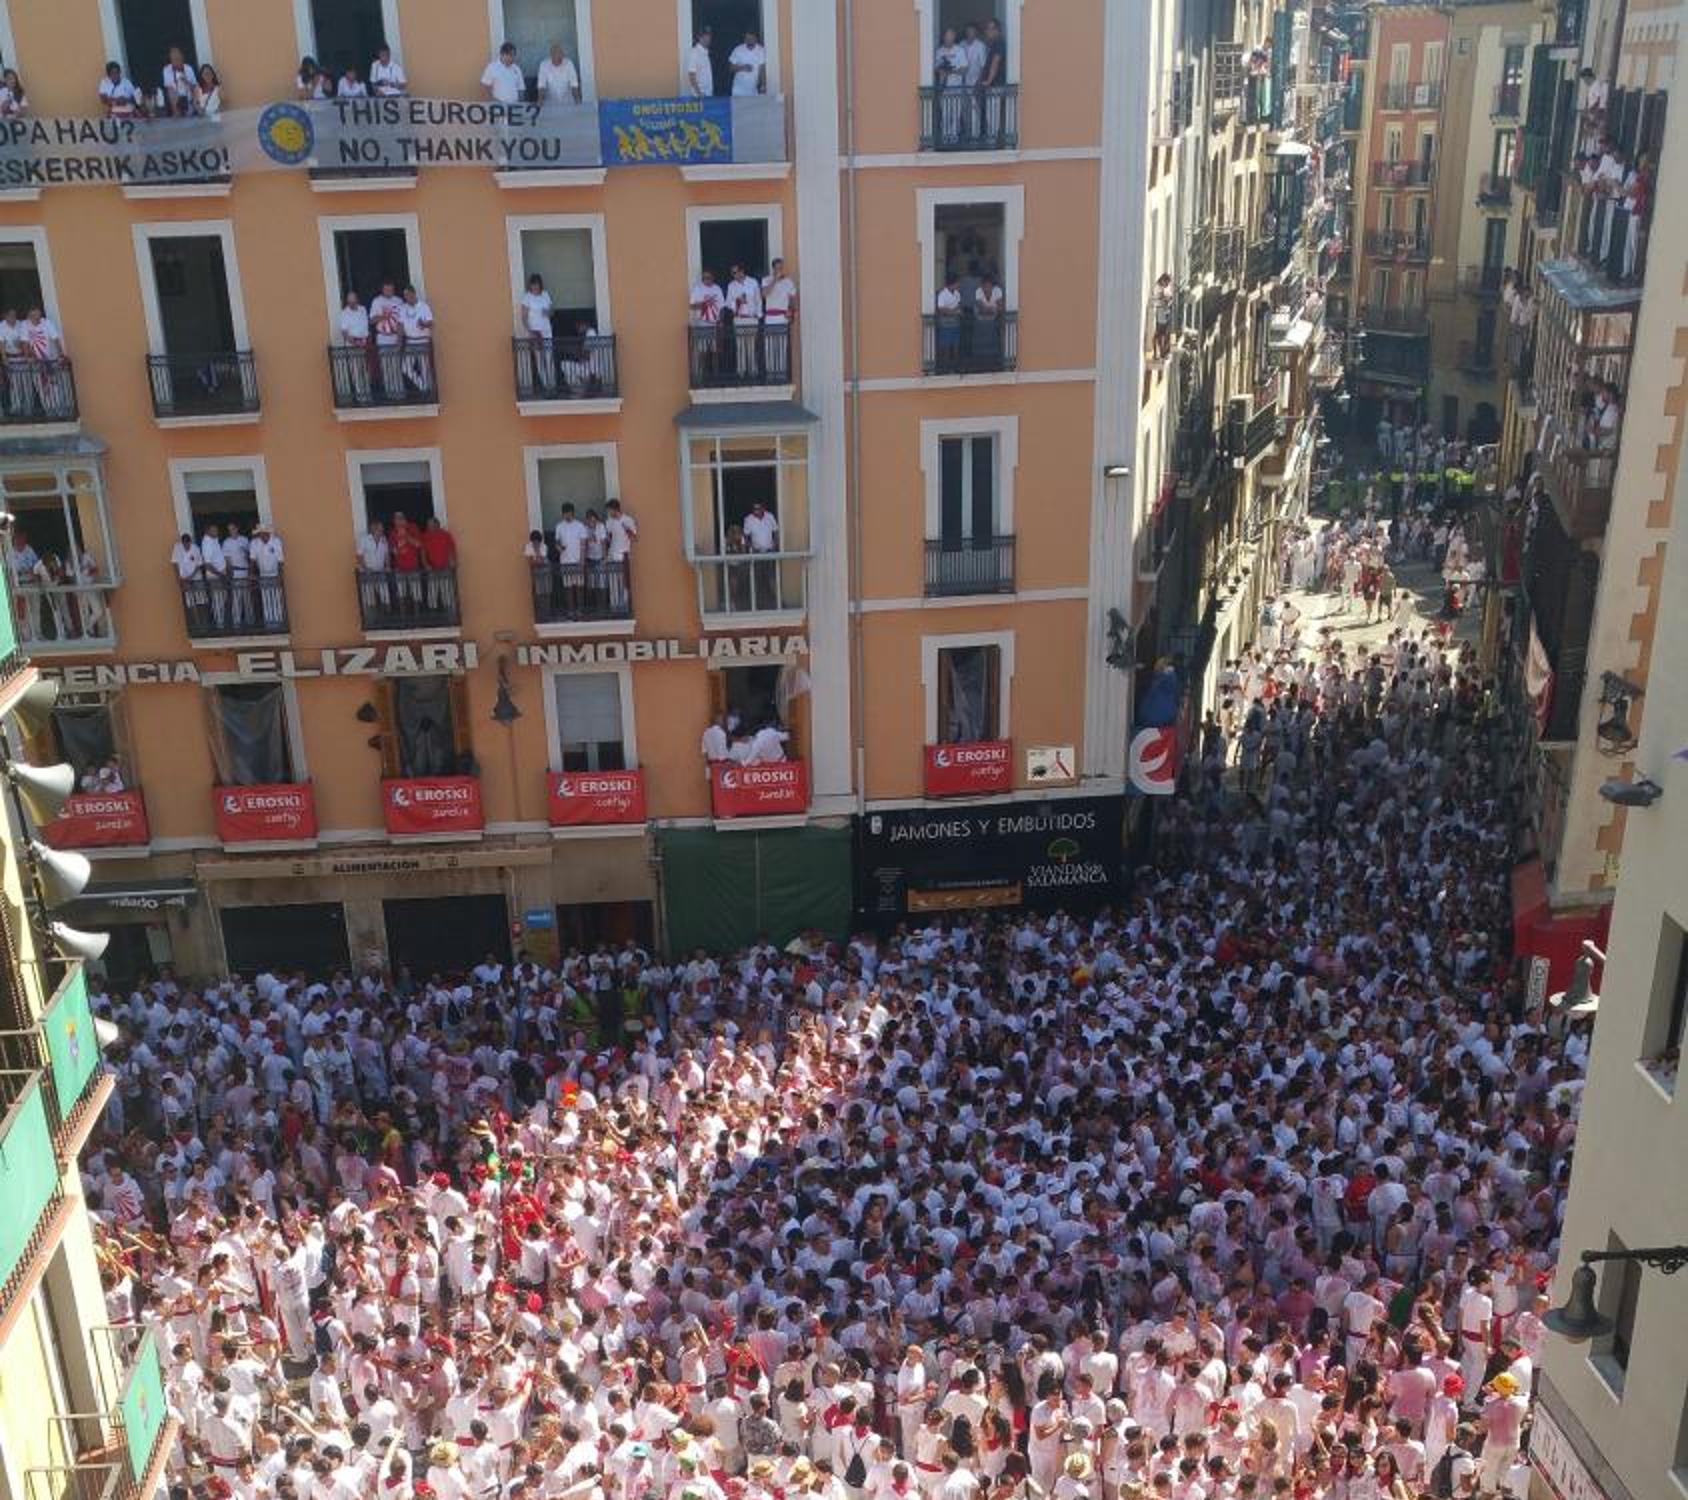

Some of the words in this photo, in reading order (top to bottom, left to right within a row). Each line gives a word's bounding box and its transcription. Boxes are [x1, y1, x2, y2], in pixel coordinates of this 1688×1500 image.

[333, 100, 400, 125] THIS
[410, 100, 541, 126] EUROPE?
[55, 119, 135, 145] HAU?
[339, 137, 389, 166] NO,
[396, 137, 493, 162] THANK
[501, 137, 561, 162] YOU
[143, 147, 231, 178] ASKO!
[237, 642, 480, 678] ELIZARI
[517, 635, 809, 666] INMOBILIARIA
[956, 748, 1006, 763] EROSKI
[743, 771, 794, 784] EROSKI
[580, 779, 632, 793] EROSKI
[415, 788, 467, 801] EROSKI
[74, 801, 129, 815] EROSKI
[246, 796, 300, 810] EROSKI
[890, 820, 971, 842] JAMONES
[977, 819, 992, 835] Y
[998, 813, 1096, 834] EMBUTIDOS
[1027, 872, 1108, 887] SALAMANCA
